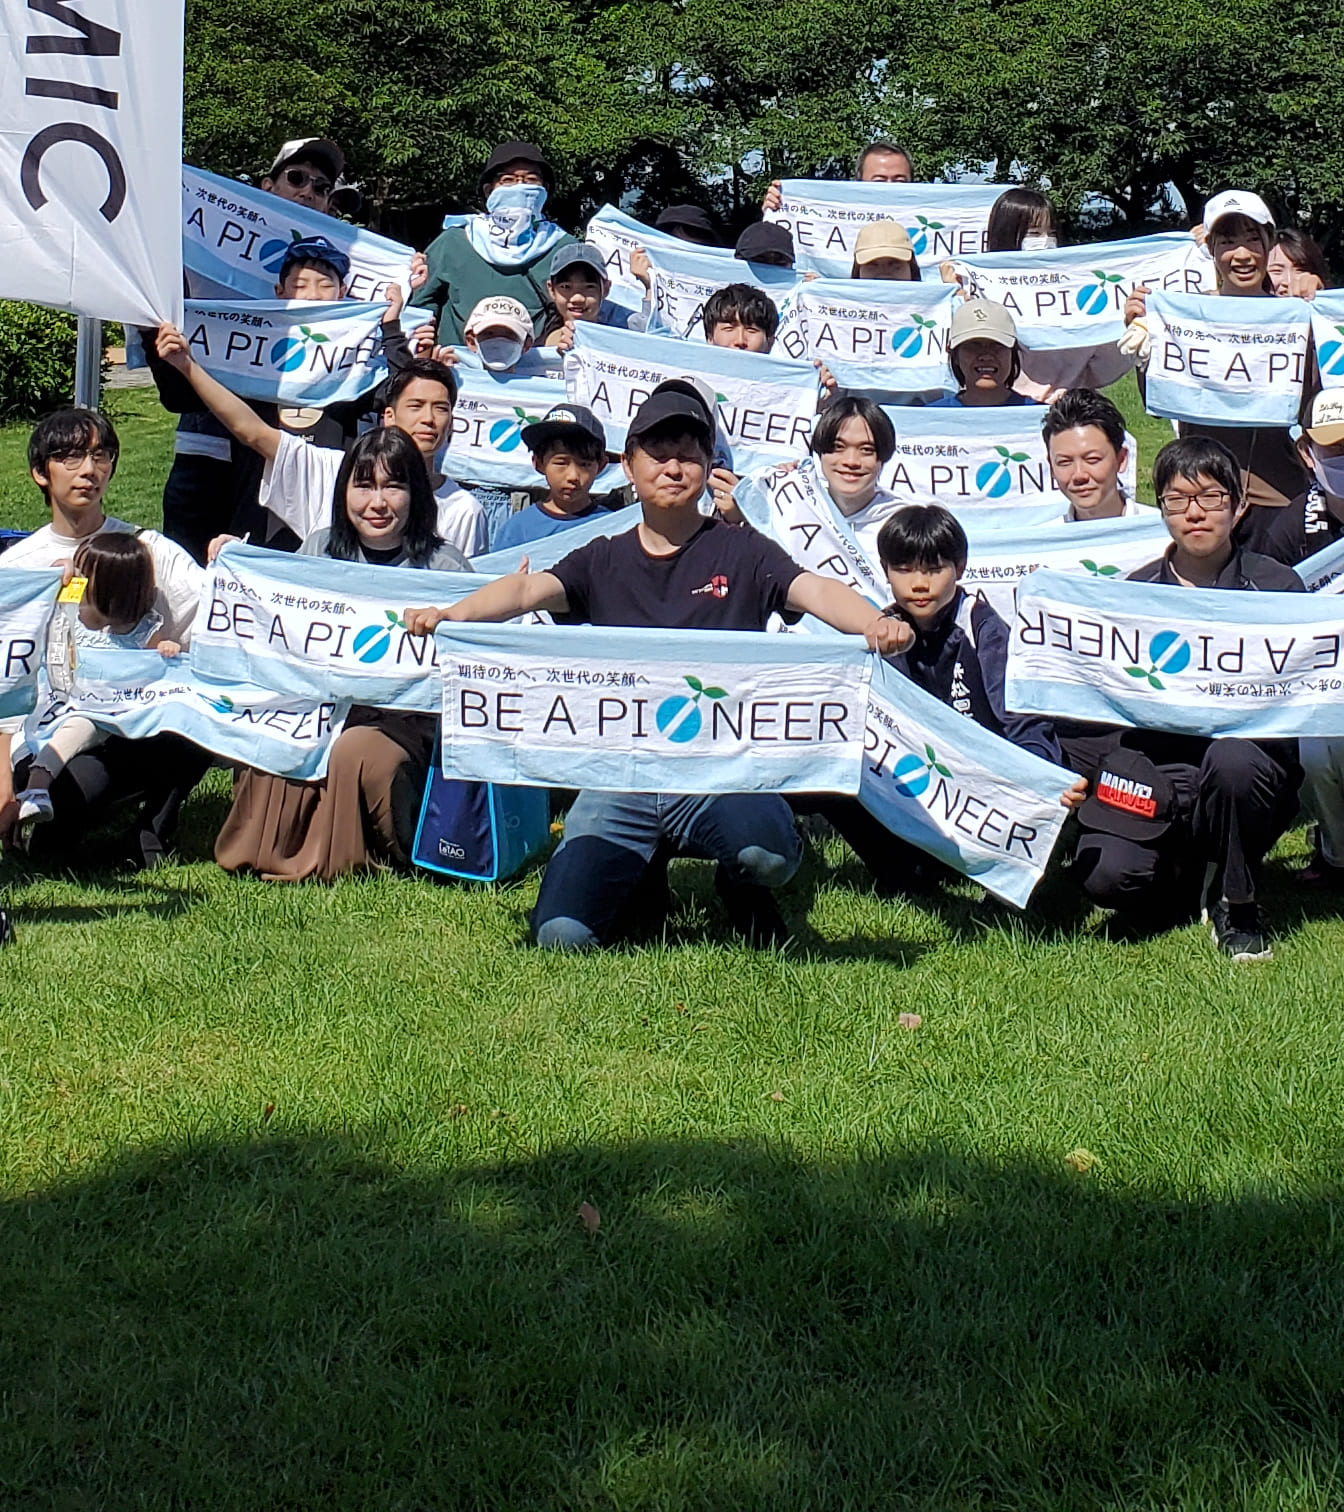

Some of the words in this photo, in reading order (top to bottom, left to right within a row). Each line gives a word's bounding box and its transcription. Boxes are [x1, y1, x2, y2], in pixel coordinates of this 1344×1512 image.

[187, 207, 205, 237] A
[826, 226, 847, 252] A
[607, 249, 623, 276] A
[485, 302, 521, 316] TOKYO
[1003, 292, 1023, 316] A
[189, 324, 210, 356] A
[816, 323, 838, 350] A
[852, 327, 950, 358] PION
[1164, 342, 1210, 379] BE
[1225, 353, 1251, 382] A
[592, 381, 612, 412] A
[891, 463, 916, 494] A
[931, 462, 1060, 498] PION
[790, 523, 822, 551] A
[207, 599, 254, 639] BE
[269, 614, 289, 650] A
[1018, 611, 1243, 674] PIONEER
[1264, 638, 1296, 674] A
[457, 664, 650, 687] 期待の先へ、次世代の笑顔へ
[461, 690, 524, 732] BE
[543, 695, 577, 735] A
[598, 696, 848, 743] PIONEER
